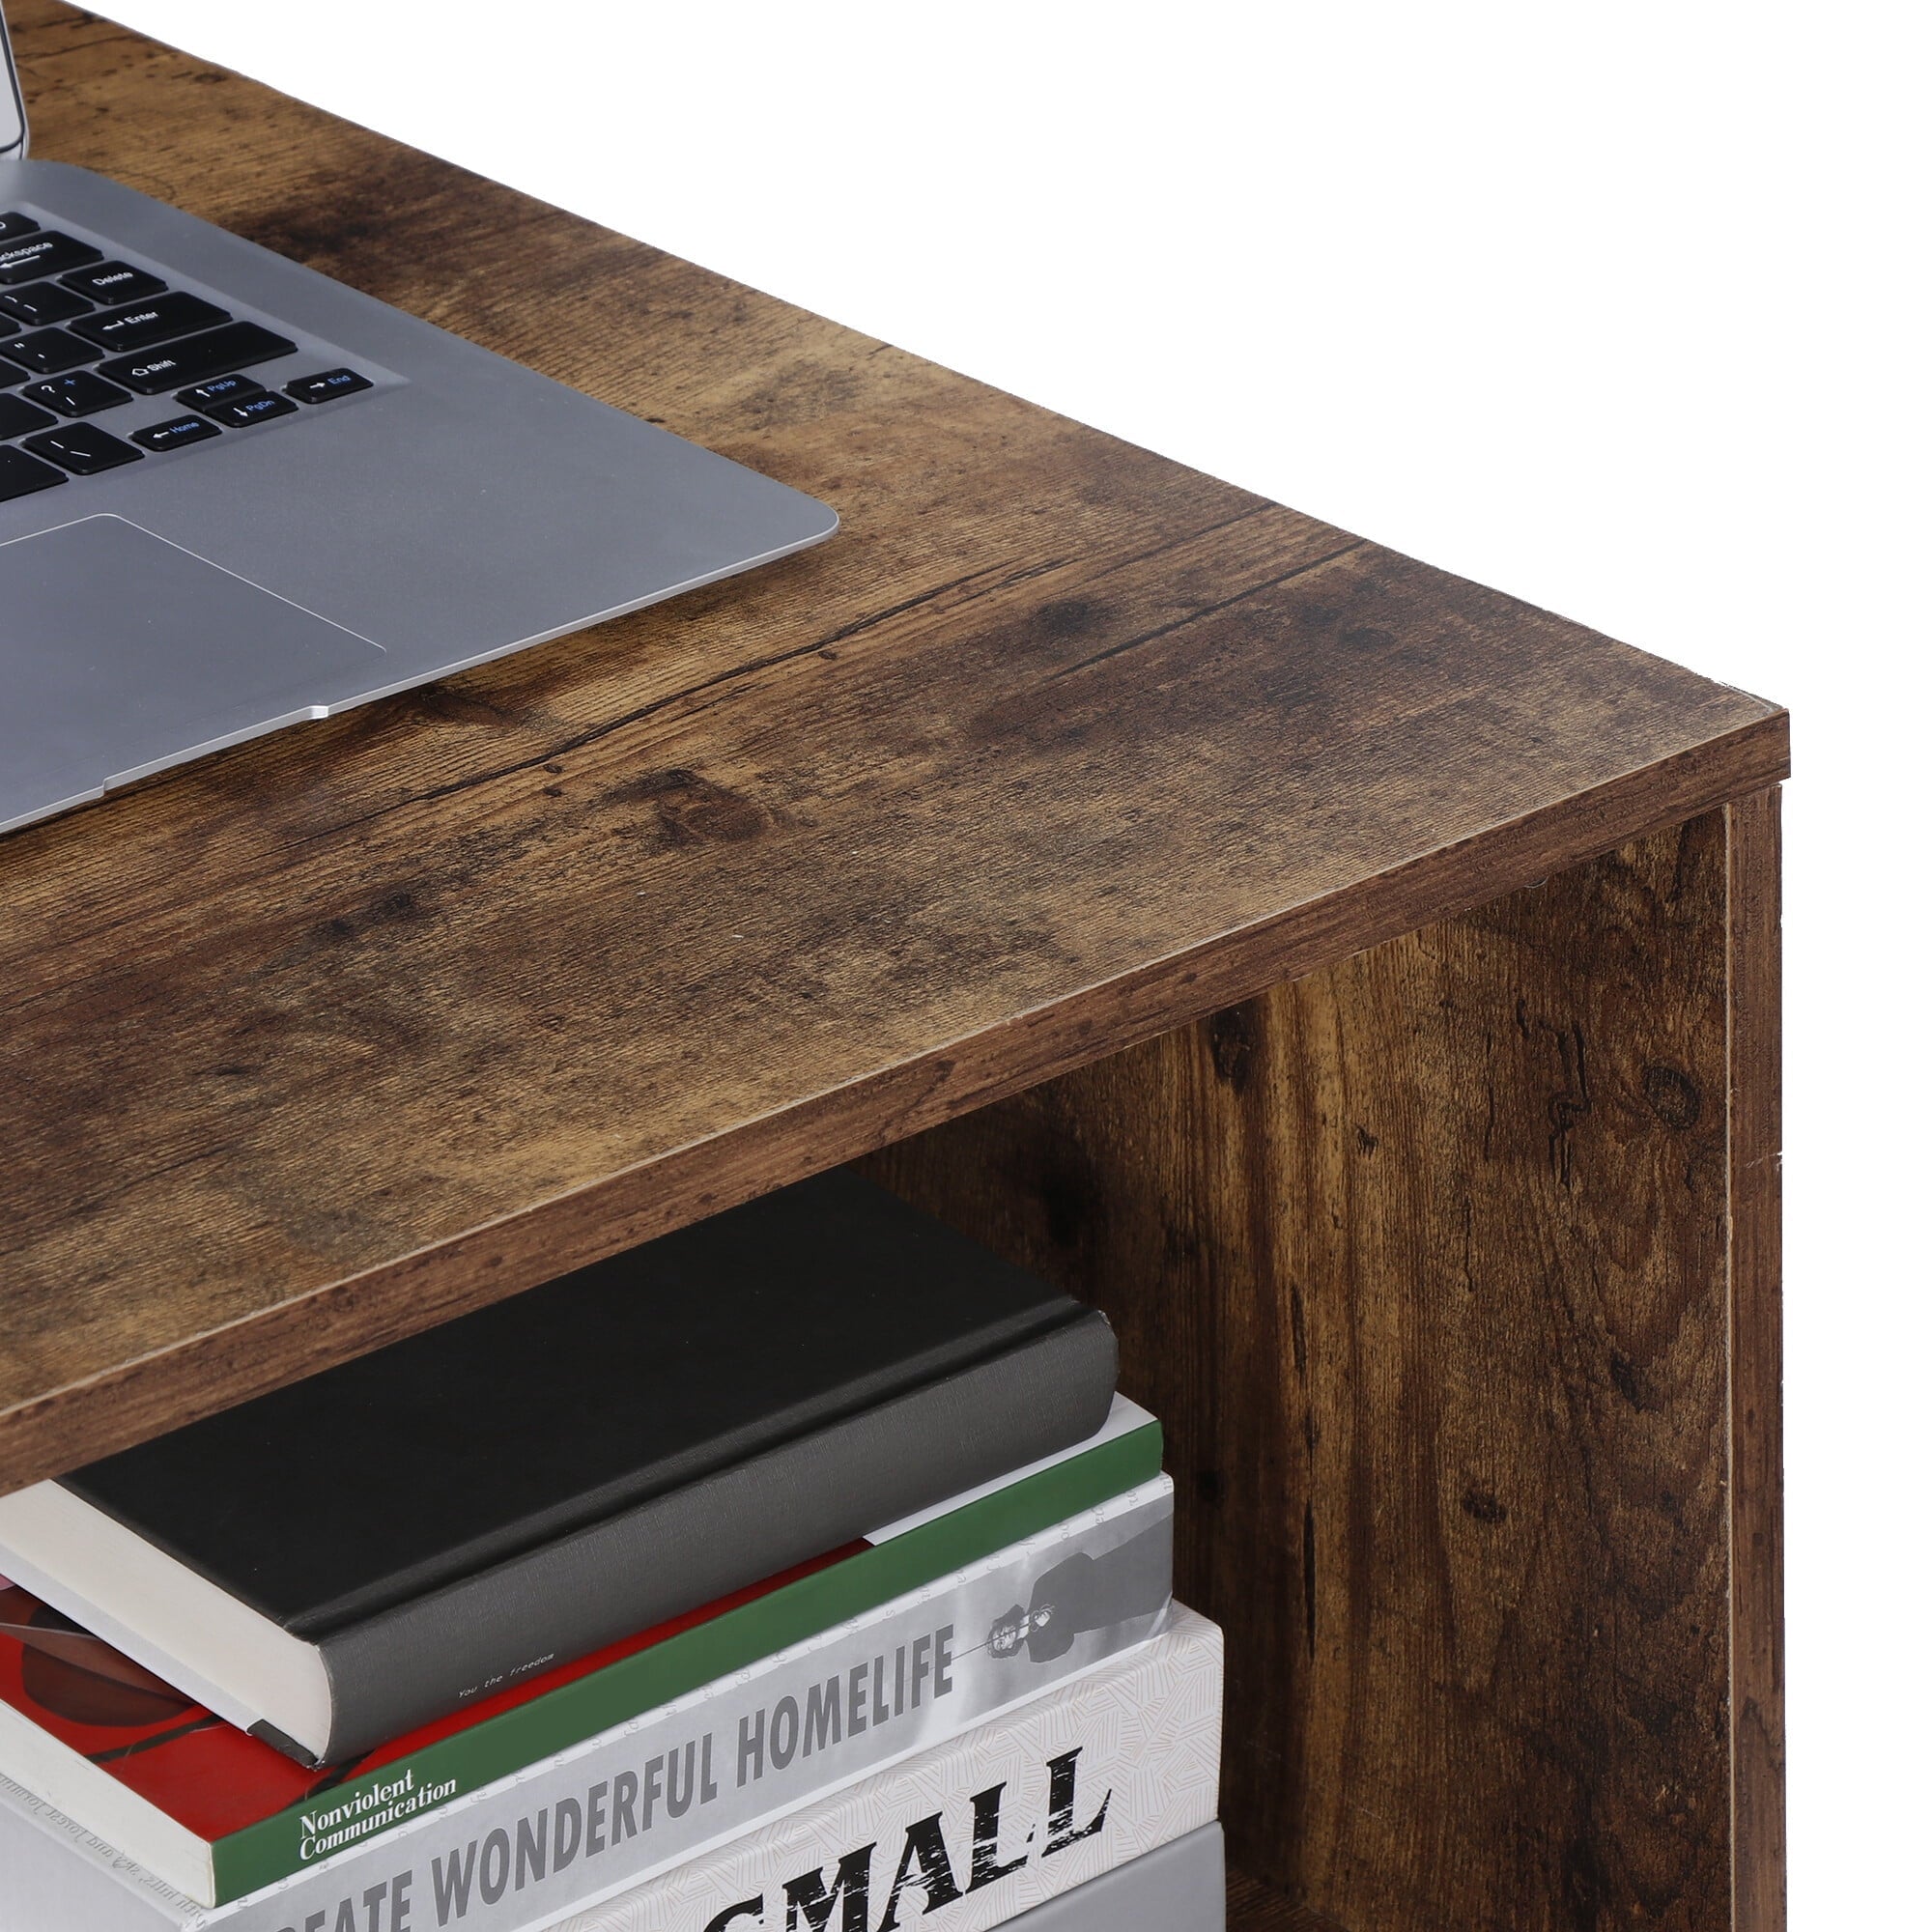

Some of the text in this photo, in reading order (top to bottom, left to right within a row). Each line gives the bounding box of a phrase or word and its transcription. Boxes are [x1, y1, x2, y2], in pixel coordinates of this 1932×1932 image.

[92, 270, 133, 286] Delete
[125, 311, 158, 325] Enter
[147, 359, 176, 373] Shift
[208, 380, 236, 392] PgUp
[327, 375, 352, 385] End
[245, 399, 275, 412] PgDn
[170, 421, 200, 434] Home
[458, 1653, 554, 1698] You the freedom
[431, 1624, 953, 1927] WONDERFUL HOMELIFE
[299, 1769, 414, 1840] Nonviolent
[299, 1778, 457, 1861] Communication
